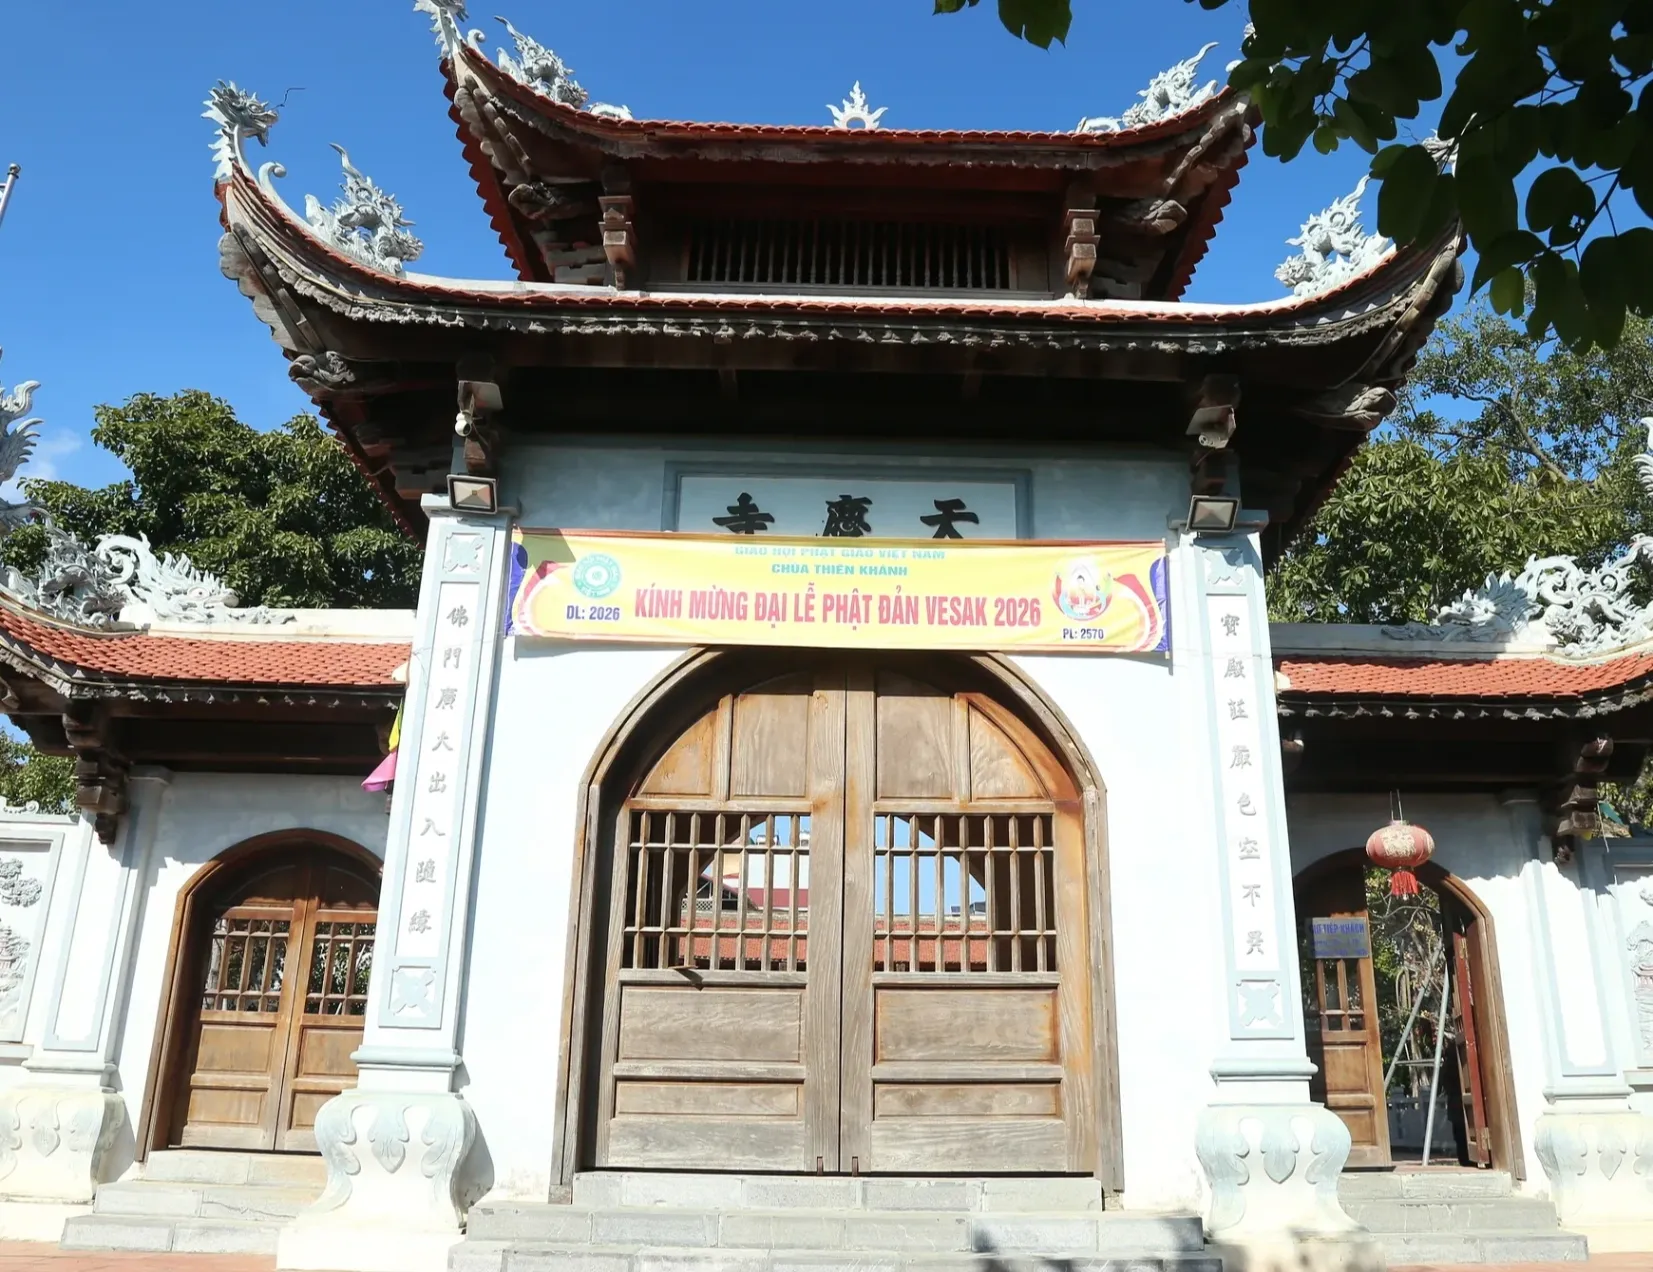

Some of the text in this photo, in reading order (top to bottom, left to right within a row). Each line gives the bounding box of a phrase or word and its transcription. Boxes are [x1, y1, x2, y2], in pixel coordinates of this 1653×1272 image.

[912, 549, 945, 560] NAM
[566, 605, 620, 621] DL: 2026
[635, 582, 1041, 631] KÍNH MỪNG ĐẠI LỄ PHẬT ĐẢN VESAK 2026
[1062, 628, 1104, 640] PL: 2570
